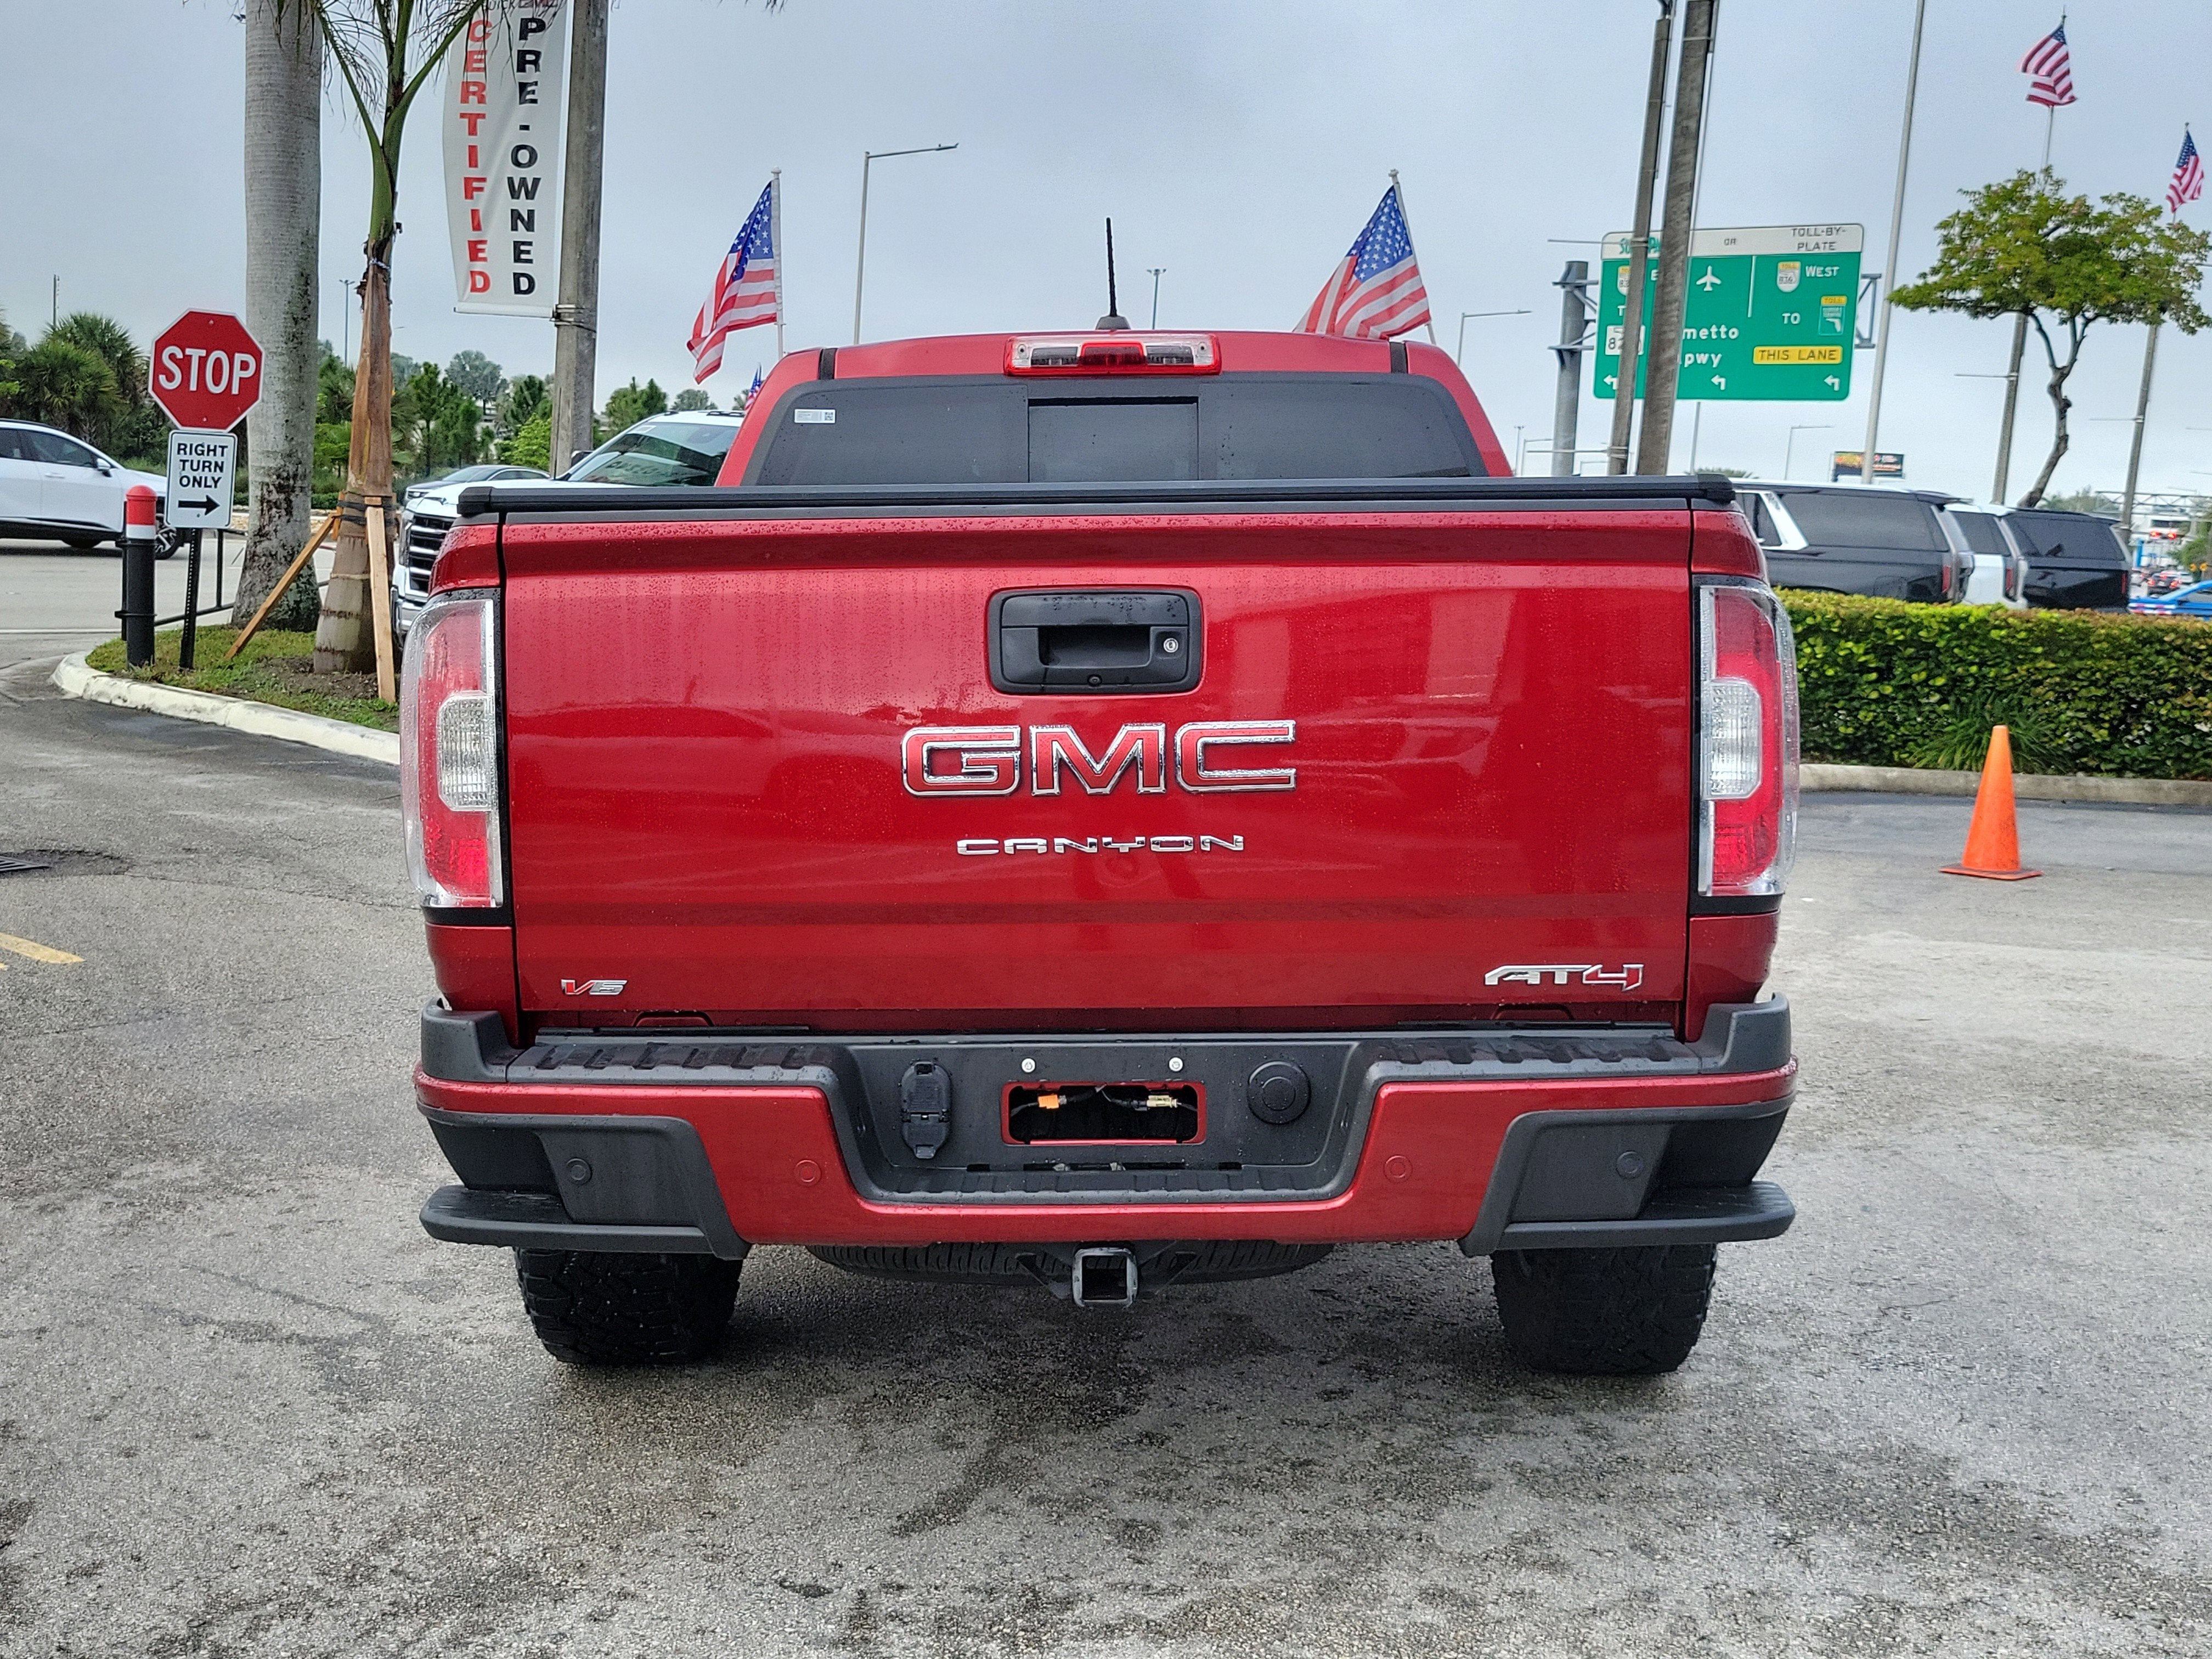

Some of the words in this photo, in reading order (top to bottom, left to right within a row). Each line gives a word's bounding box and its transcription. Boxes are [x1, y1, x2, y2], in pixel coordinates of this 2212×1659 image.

[459, 19, 492, 294] CERTIFIED
[507, 18, 546, 295] PRE-OWNED
[1791, 227, 1847, 237] TOLL-BY-
[1797, 242, 1836, 251] PLATE
[1805, 266, 1839, 277] WEST
[1782, 313, 1801, 324] TO
[1683, 324, 1739, 339] metto
[1677, 353, 1723, 368] pwy
[1759, 349, 1790, 361] THIS
[1798, 349, 1837, 360] LANE
[159, 346, 256, 395] STOP
[177, 442, 228, 458] RIGHT
[179, 459, 224, 473] TURN
[179, 474, 222, 489] ONLY
[901, 720, 1296, 797] GMC
[956, 835, 1244, 855] CANYON
[1485, 964, 1644, 991] AT4
[561, 979, 628, 995] V6
